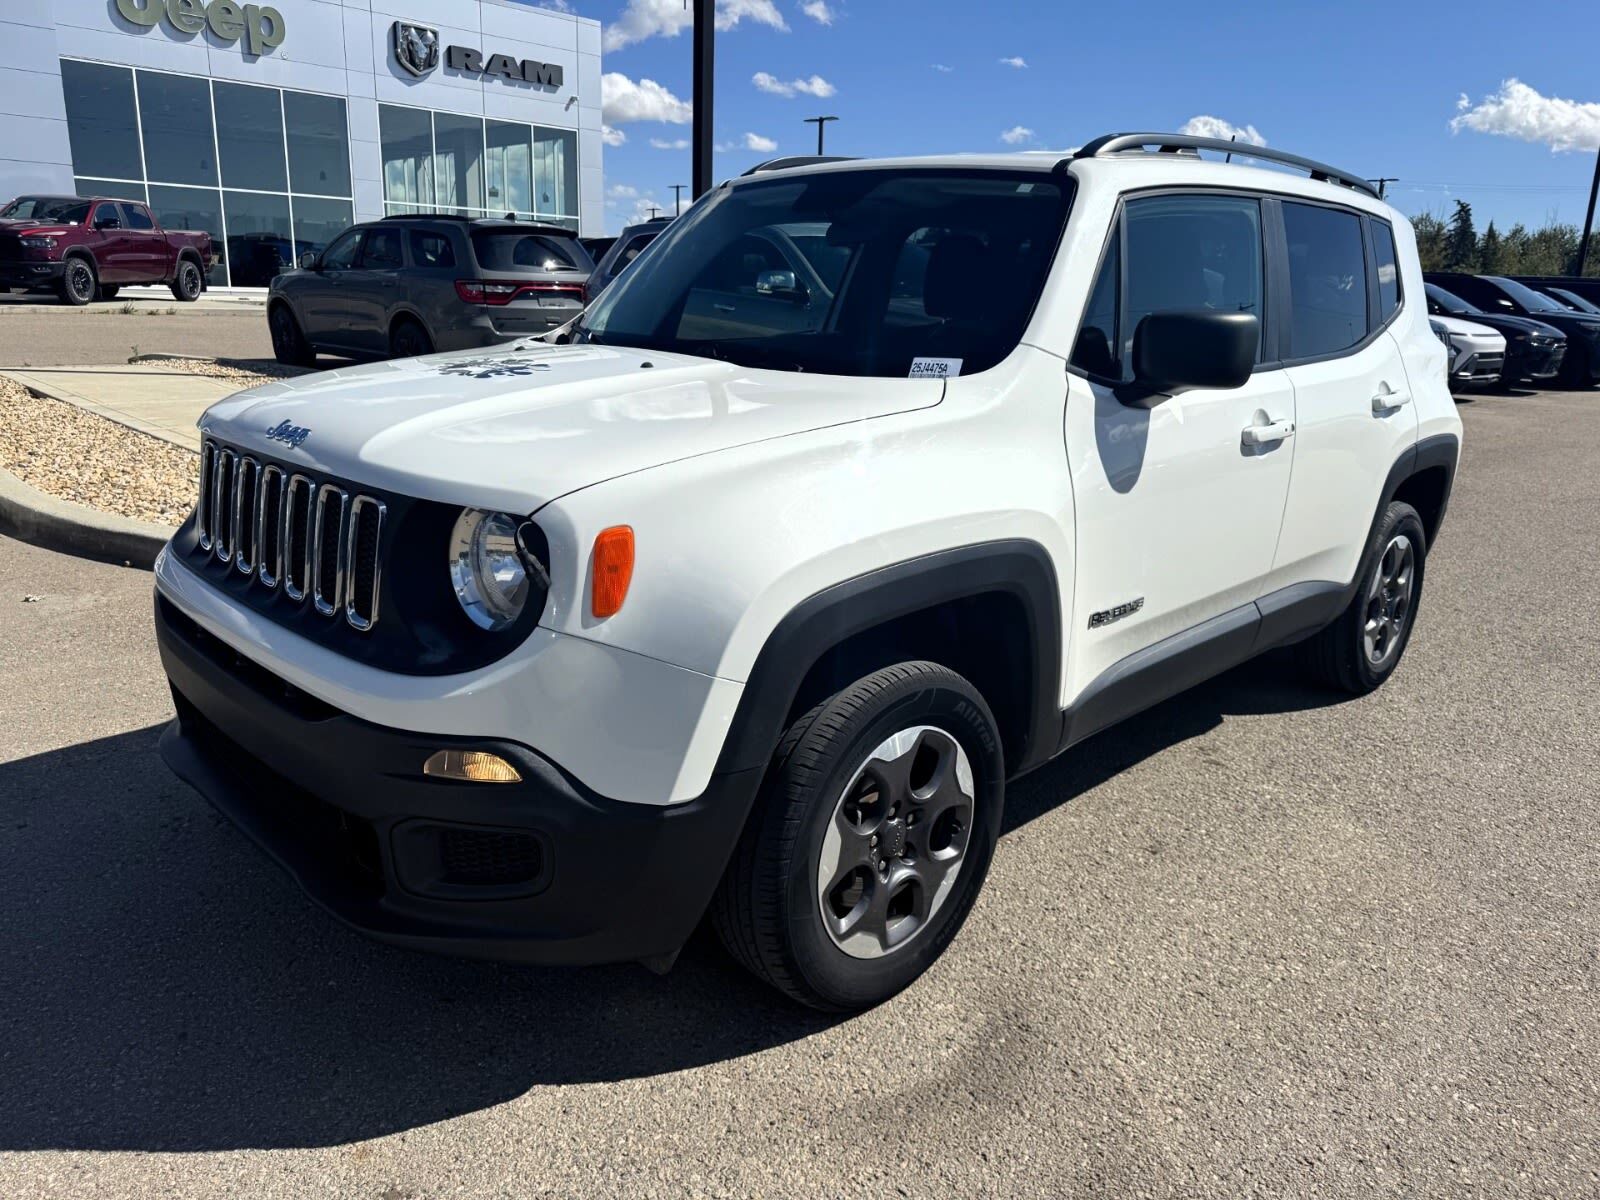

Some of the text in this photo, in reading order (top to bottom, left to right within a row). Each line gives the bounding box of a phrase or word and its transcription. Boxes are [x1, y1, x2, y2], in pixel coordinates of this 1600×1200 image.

[449, 45, 563, 87] RAM
[911, 362, 948, 374] 25J4475A
[266, 419, 312, 449] Jeep
